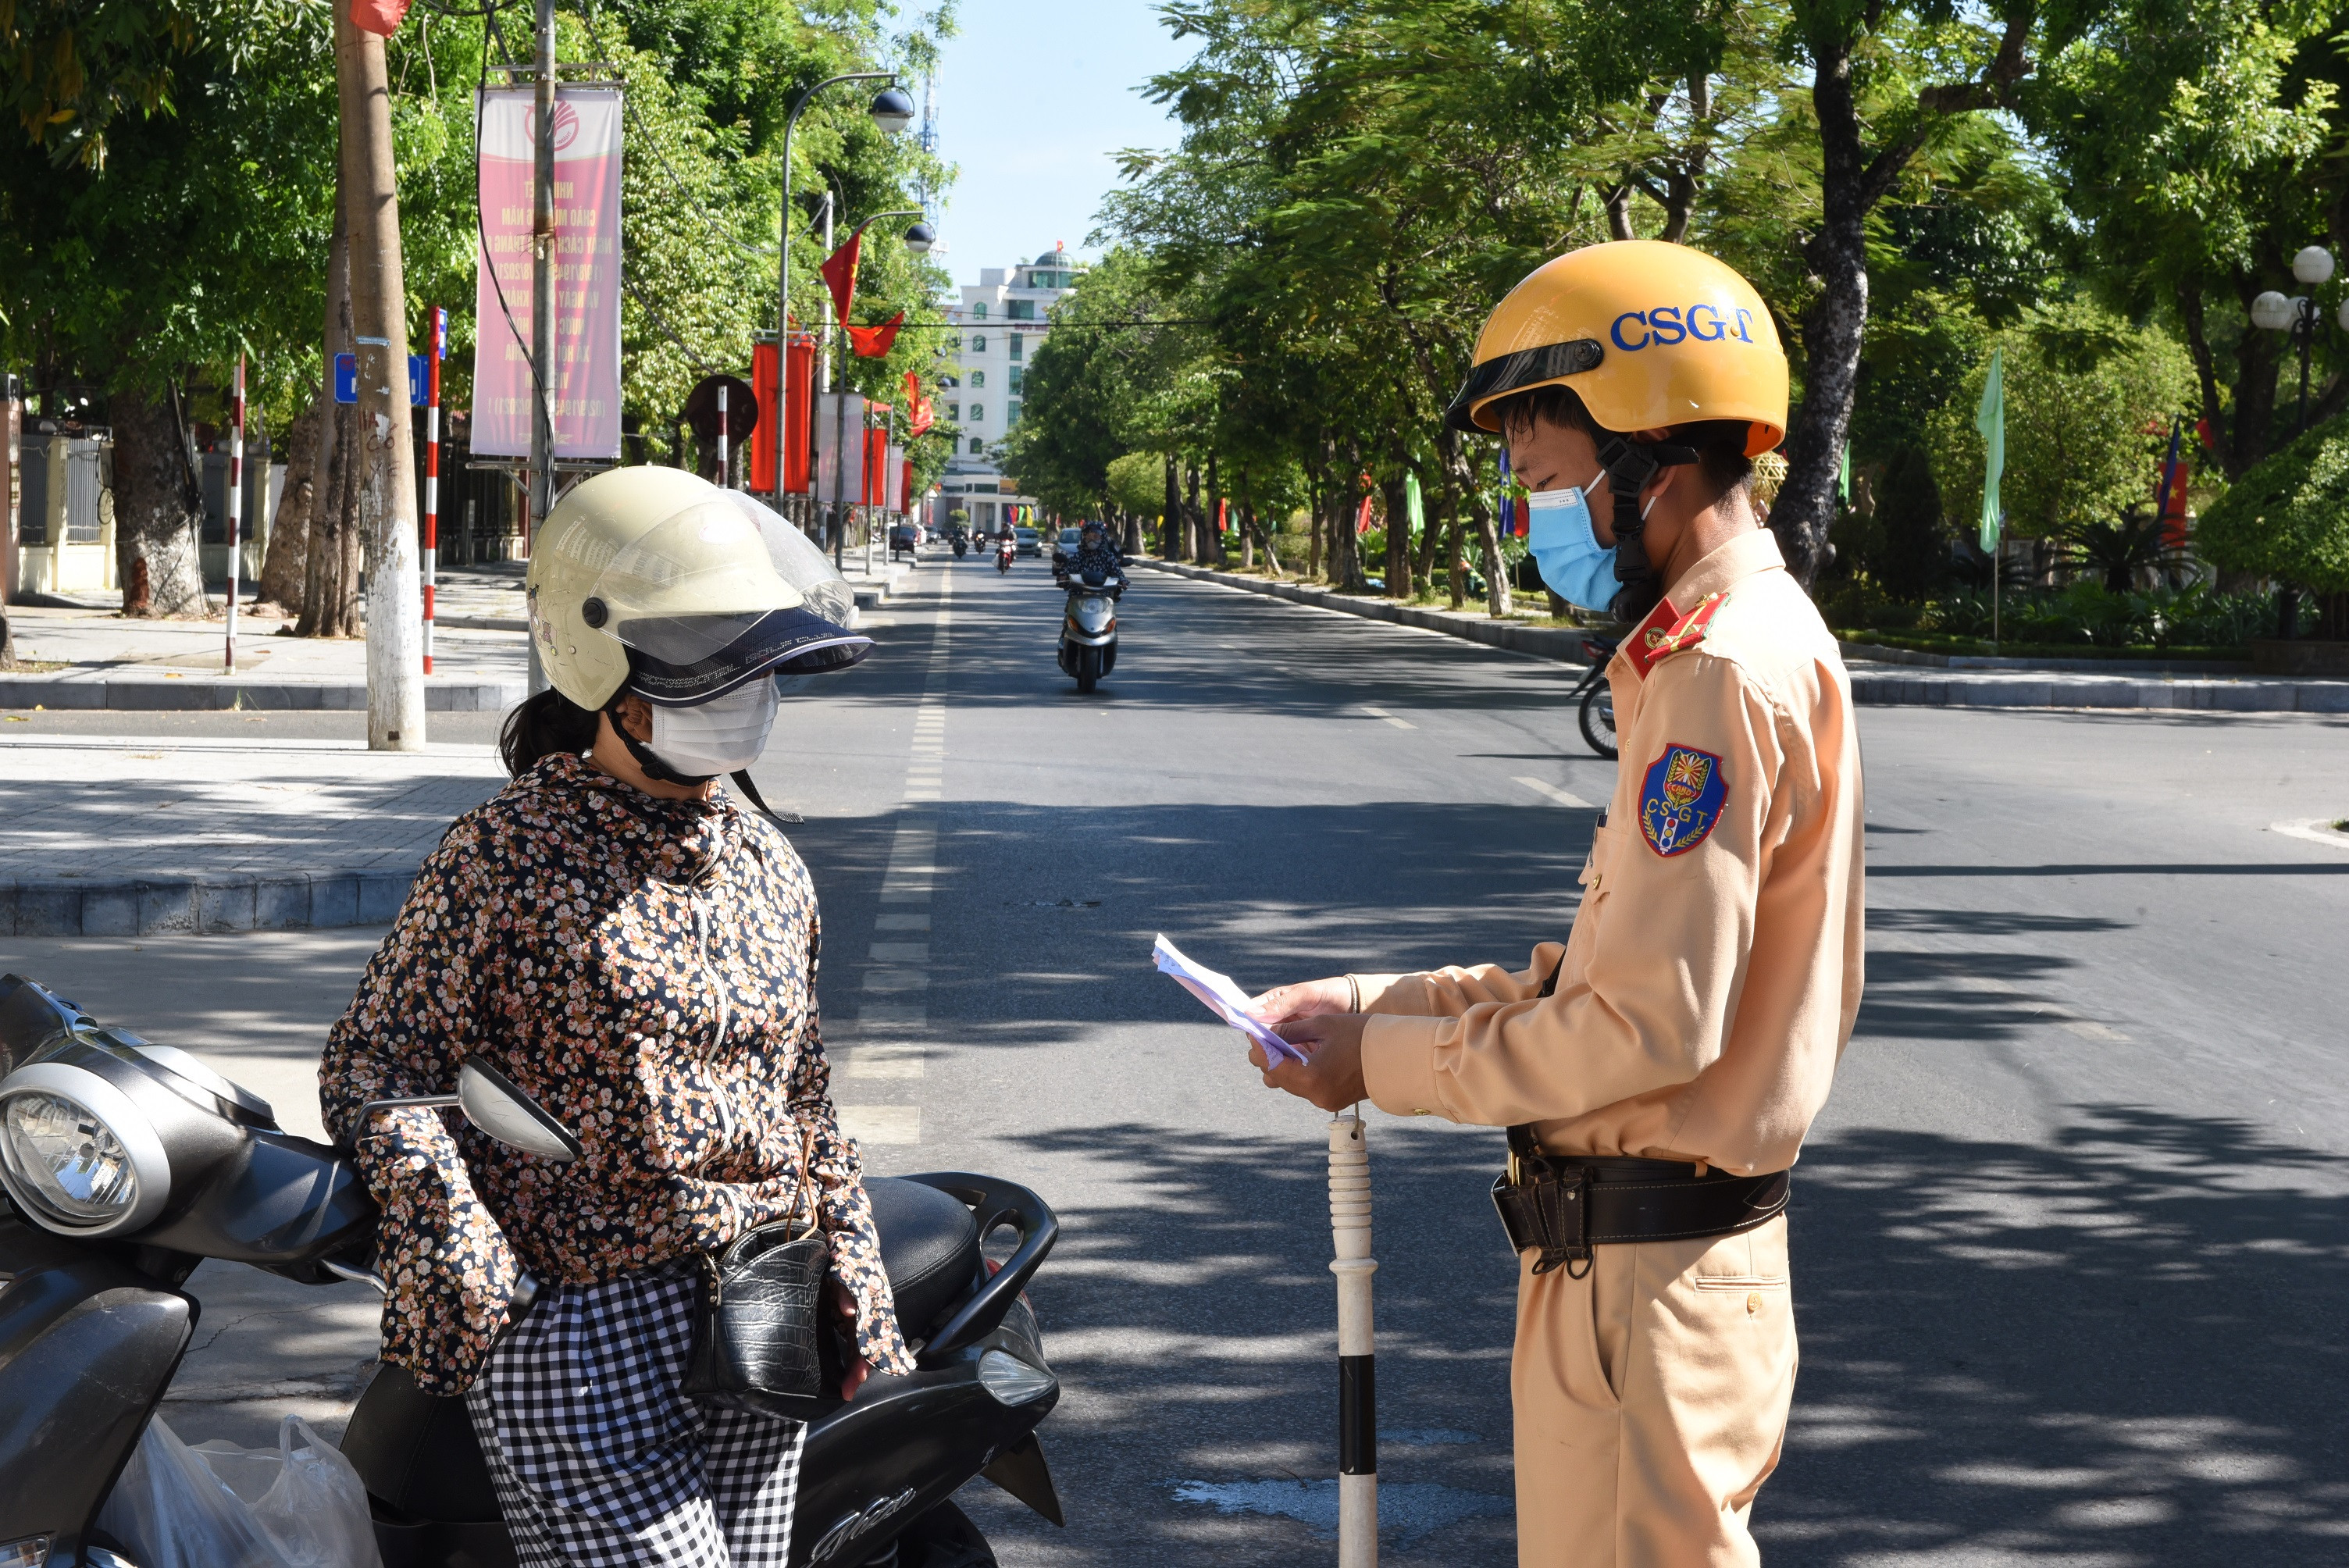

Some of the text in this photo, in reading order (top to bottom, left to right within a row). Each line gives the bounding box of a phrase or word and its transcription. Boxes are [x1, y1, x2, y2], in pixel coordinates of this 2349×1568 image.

[1610, 304, 1754, 351] CSGT
[1671, 783, 1693, 796] CAND
[1647, 798, 1708, 826] CSGT
